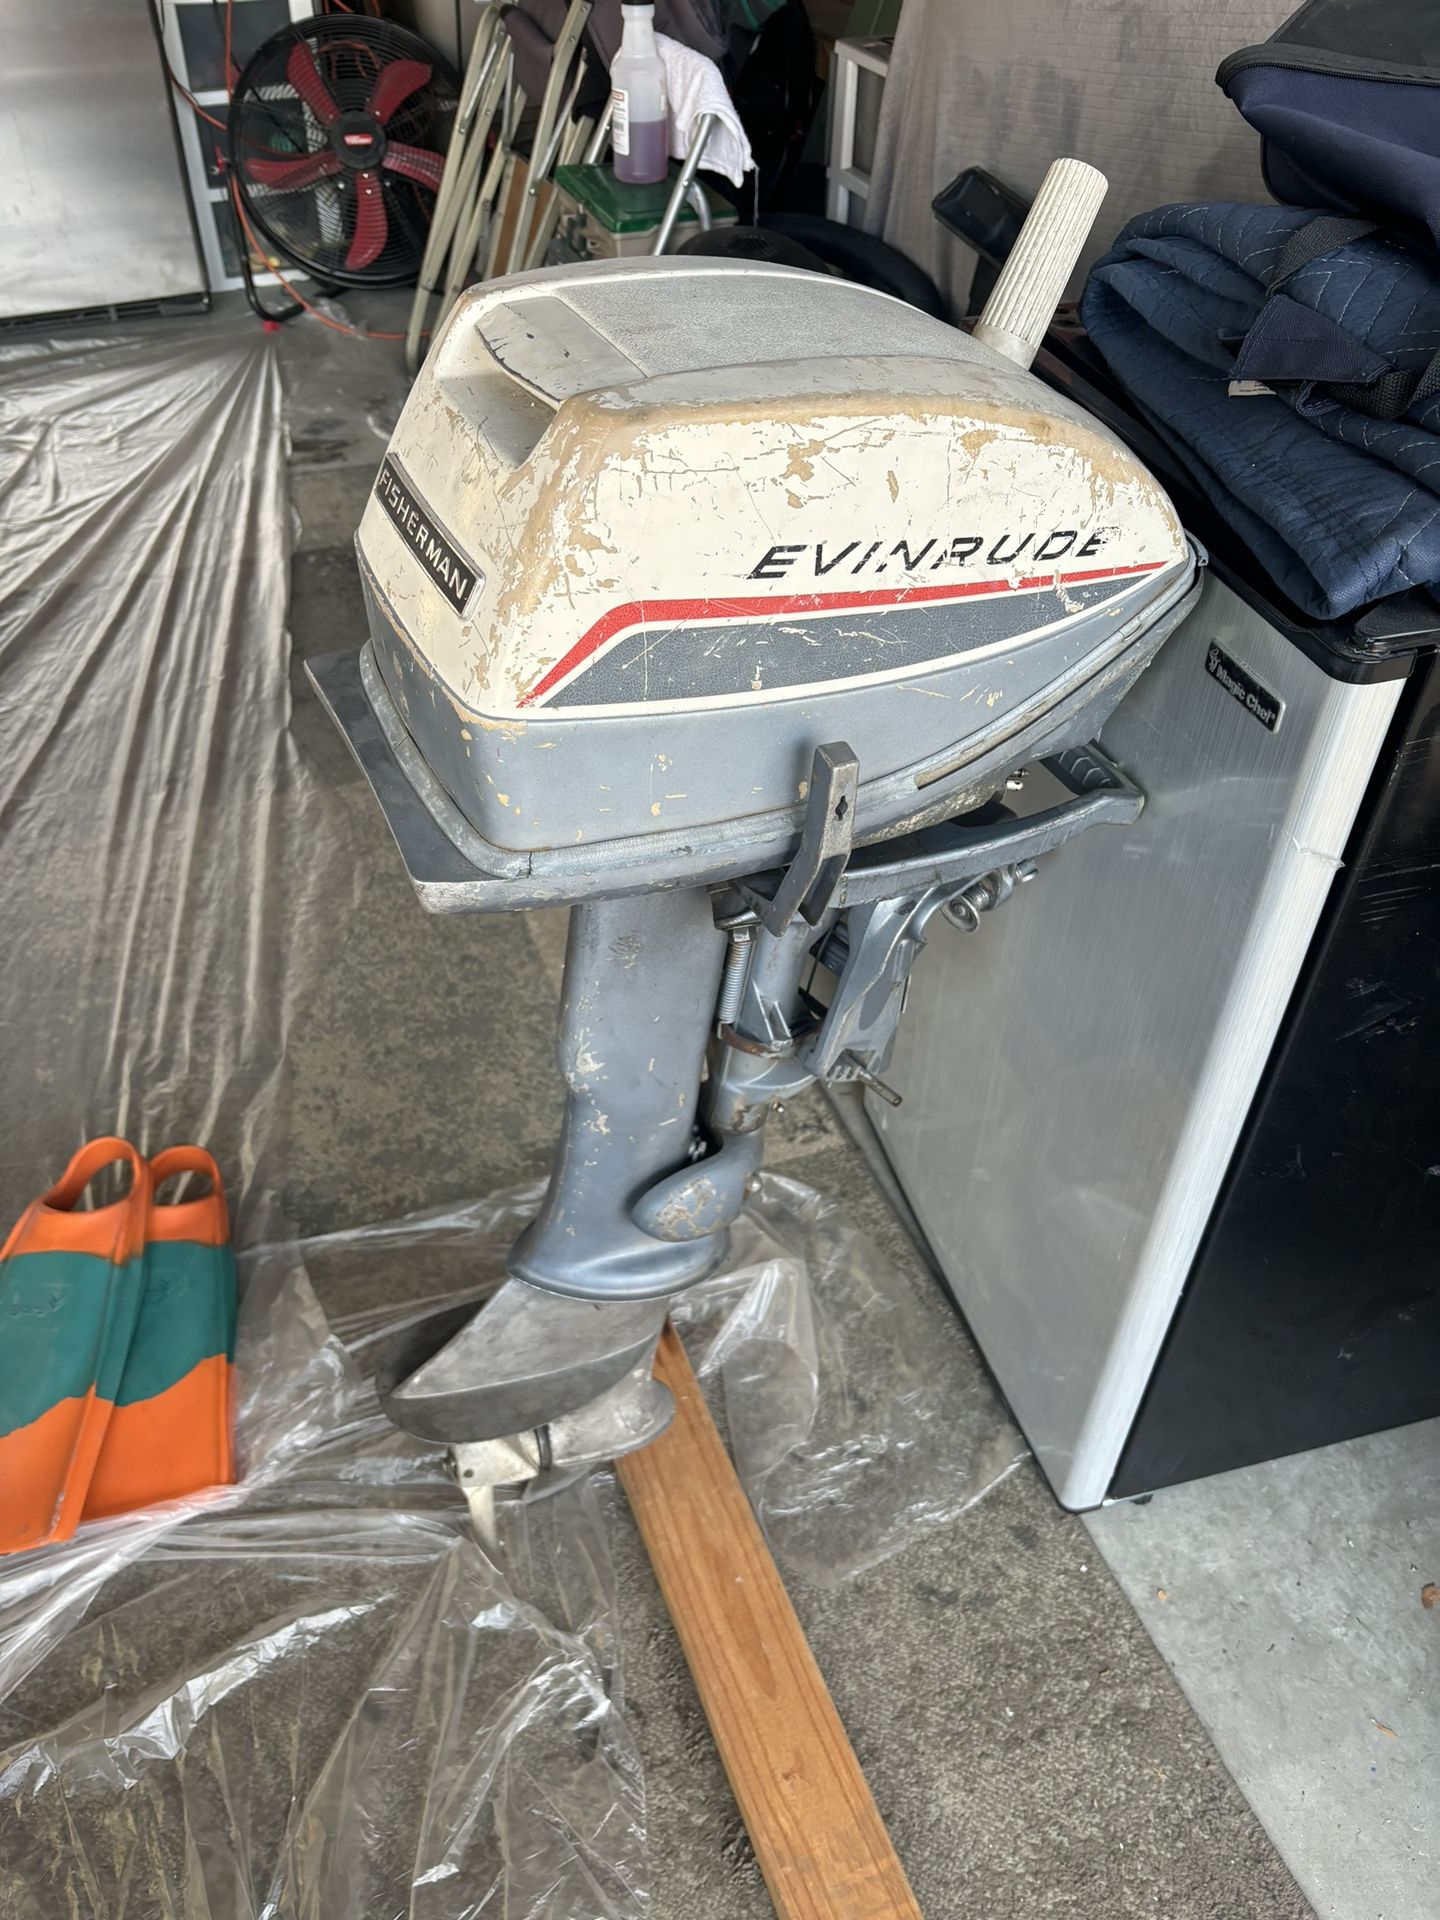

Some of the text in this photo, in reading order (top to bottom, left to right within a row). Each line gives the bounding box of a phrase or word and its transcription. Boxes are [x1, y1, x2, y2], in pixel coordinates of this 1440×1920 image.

[379, 468, 468, 600] FISHERMAN
[746, 526, 1121, 580] EVINRUDE
[1216, 664, 1246, 700] Magic
